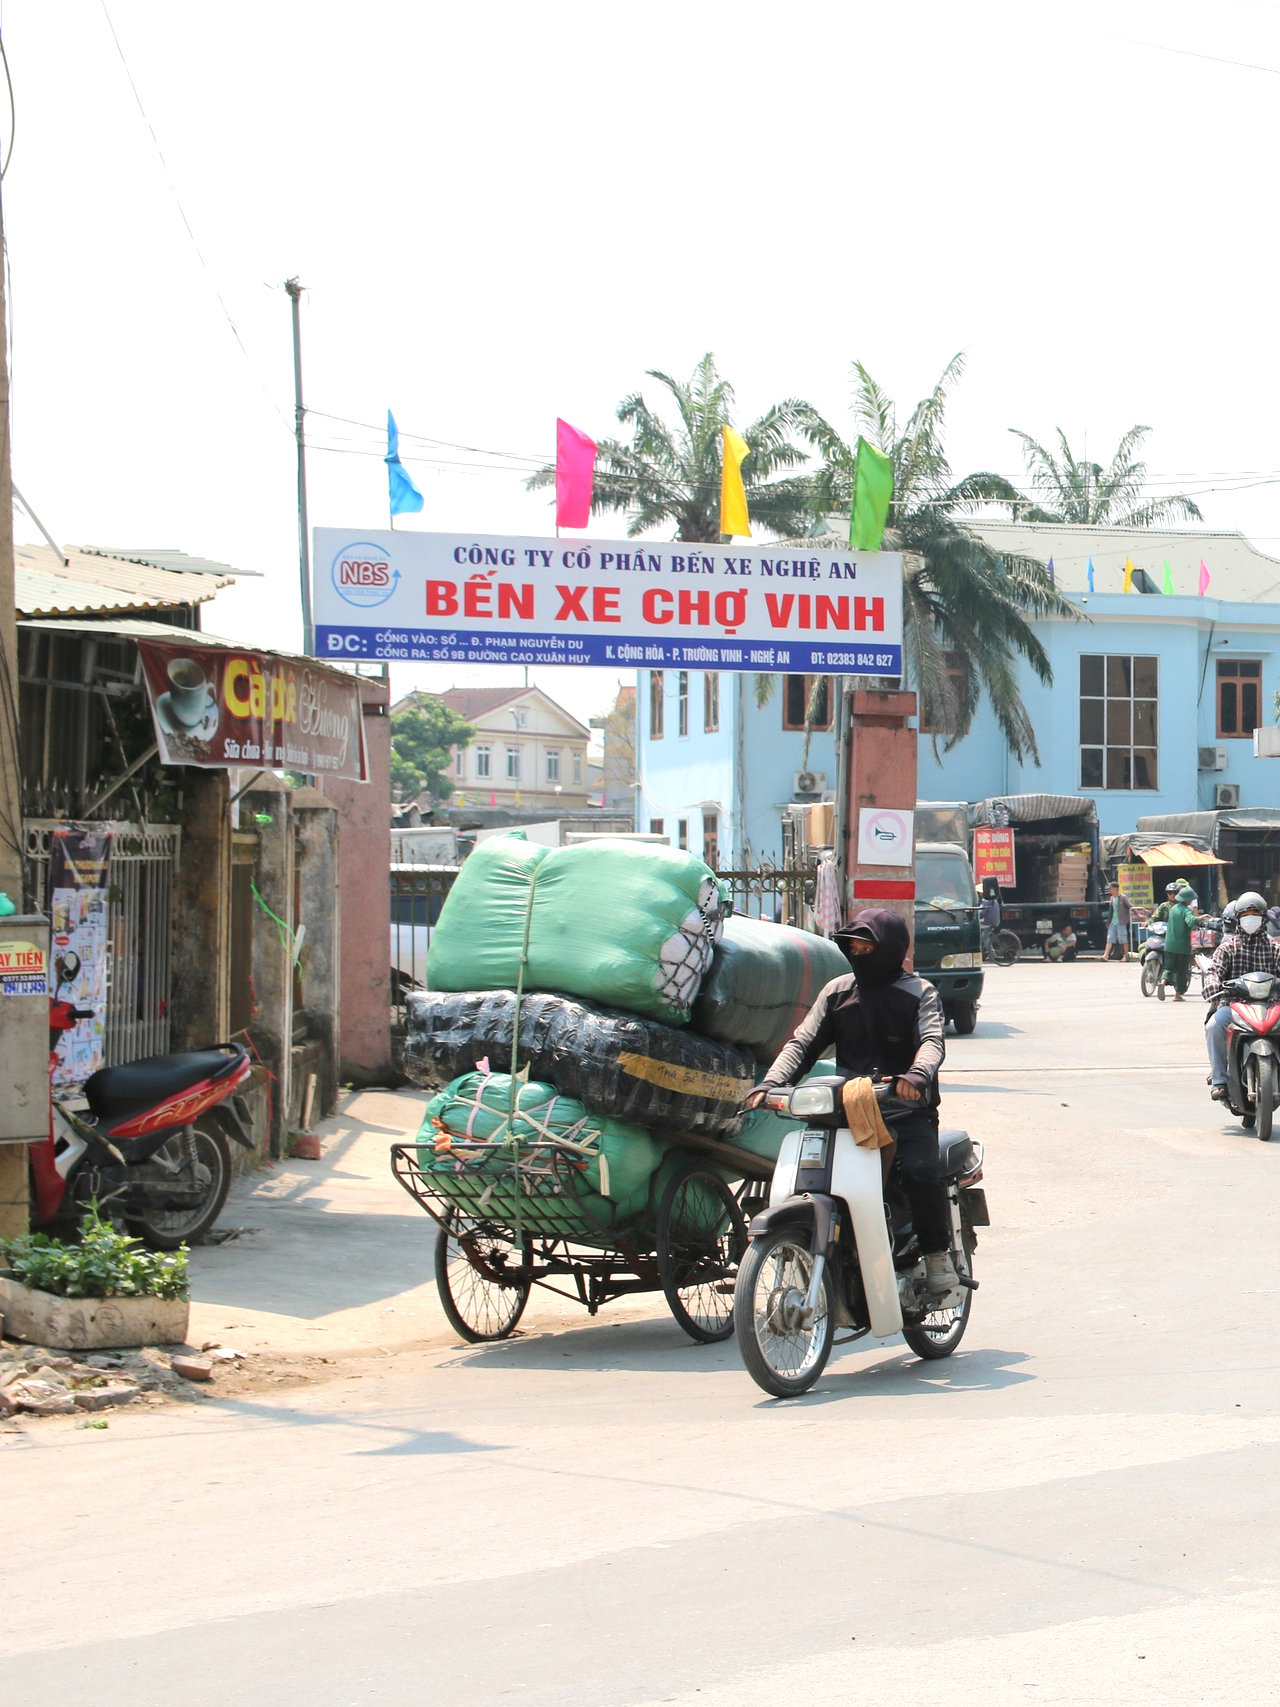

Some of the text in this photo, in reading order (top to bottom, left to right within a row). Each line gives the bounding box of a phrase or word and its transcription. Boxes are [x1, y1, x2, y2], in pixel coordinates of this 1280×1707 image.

[340, 560, 390, 586] NBS
[454, 543, 857, 581] CÔNG TY CỔ PHẦN BẾN XE NGHỆ AN
[425, 570, 885, 635] BẾN XE CHỢ VINH
[327, 634, 368, 652] ĐC:
[375, 629, 409, 643] CỔNG
[411, 632, 438, 644] VÀO:
[440, 633, 457, 646] SỐ
[471, 636, 482, 646] Đ.
[485, 637, 517, 649] PHẠM
[519, 635, 565, 649] NGUYỄN
[568, 640, 584, 650] DU
[375, 644, 591, 663] CỔNG RA: SỐ 9B ĐƯỜNG CAO XUÂN HUY
[605, 645, 616, 659] K.
[617, 643, 644, 662] CỘNG
[645, 644, 665, 660] HÒA
[672, 647, 680, 661] P.
[682, 645, 719, 662] TRƯỜNG
[720, 649, 743, 663] VINH
[750, 648, 775, 666] NGHỆ
[777, 651, 790, 664] AN
[811, 652, 893, 666] ĐT: 02383 842 627
[223, 655, 267, 720] Cà
[15, 947, 43, 967] TIỀN
